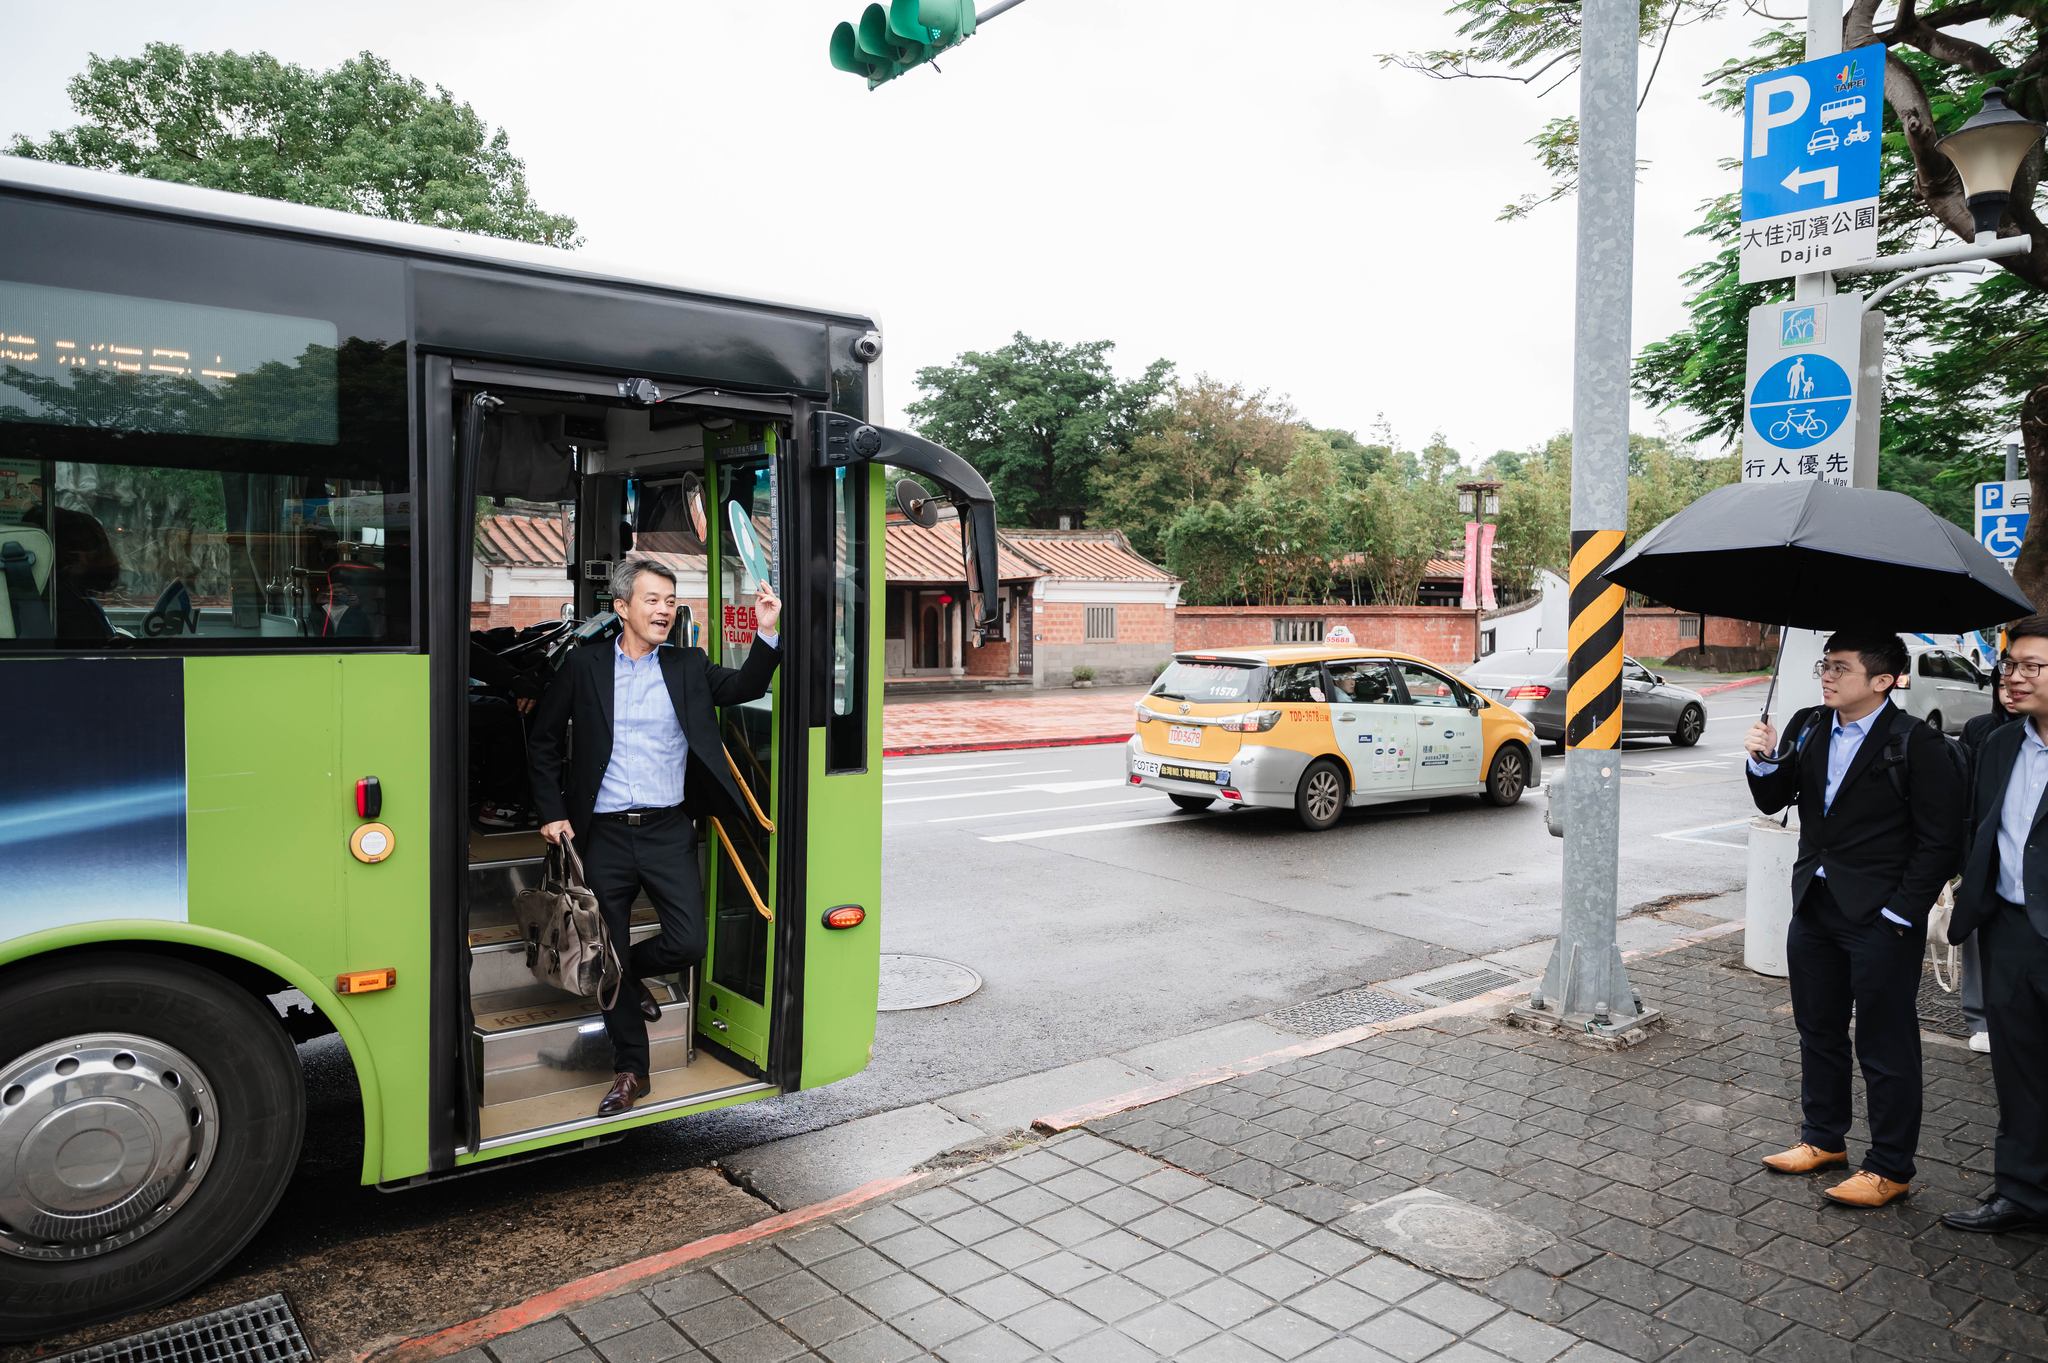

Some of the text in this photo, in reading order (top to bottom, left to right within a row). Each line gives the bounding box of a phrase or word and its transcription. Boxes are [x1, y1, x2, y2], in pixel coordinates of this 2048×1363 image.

[1834, 79, 1866, 94] TAIPEI
[1751, 75, 1811, 159] P
[1743, 206, 1876, 250] 大佳河濱公園
[1780, 243, 1833, 263] Dajia
[1745, 452, 1849, 478] 行人優先
[1985, 488, 2000, 506] P
[724, 630, 753, 644] YELLOW
[1209, 686, 1239, 697] 11578
[495, 1009, 559, 1026] KEEP
